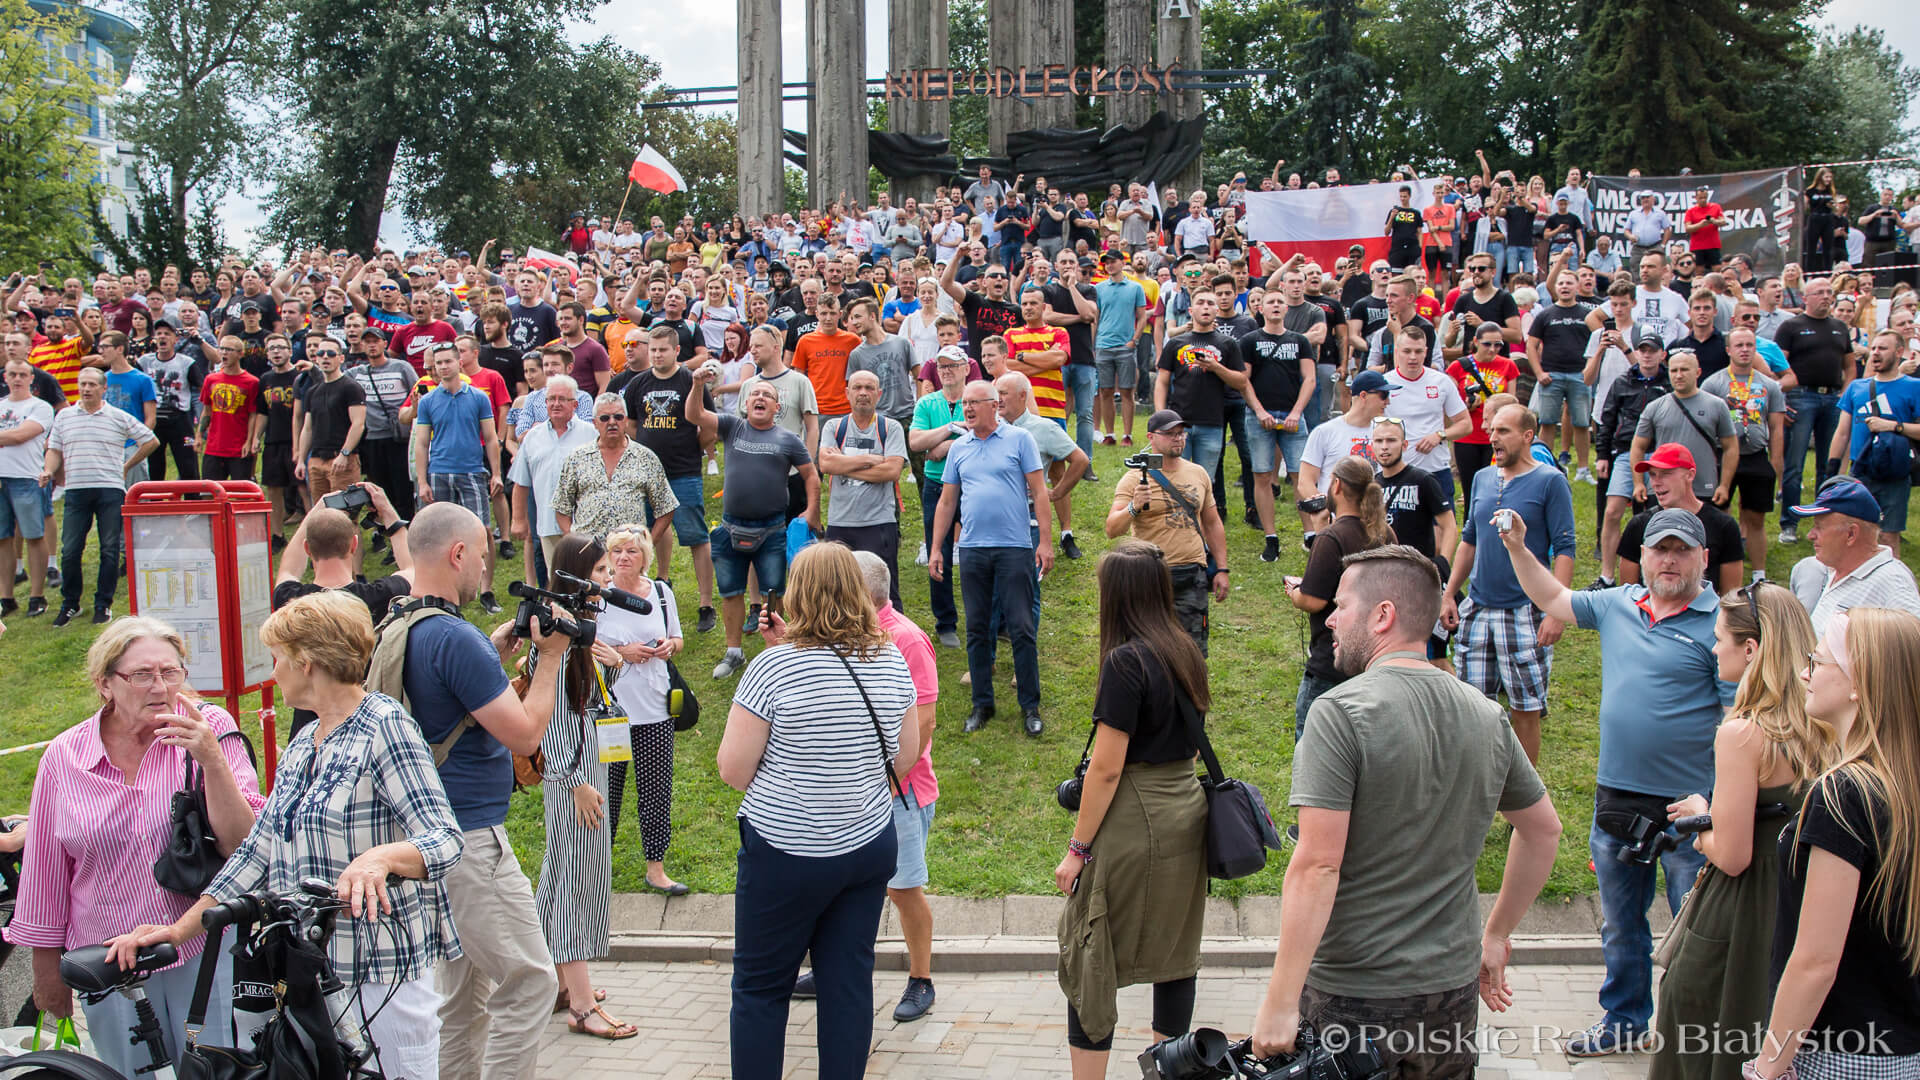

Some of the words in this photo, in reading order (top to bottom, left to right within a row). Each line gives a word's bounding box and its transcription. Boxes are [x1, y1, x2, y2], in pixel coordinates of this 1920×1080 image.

[797, 321, 818, 336] POLS
[410, 336, 435, 347] NIKE
[815, 348, 847, 358] adidas
